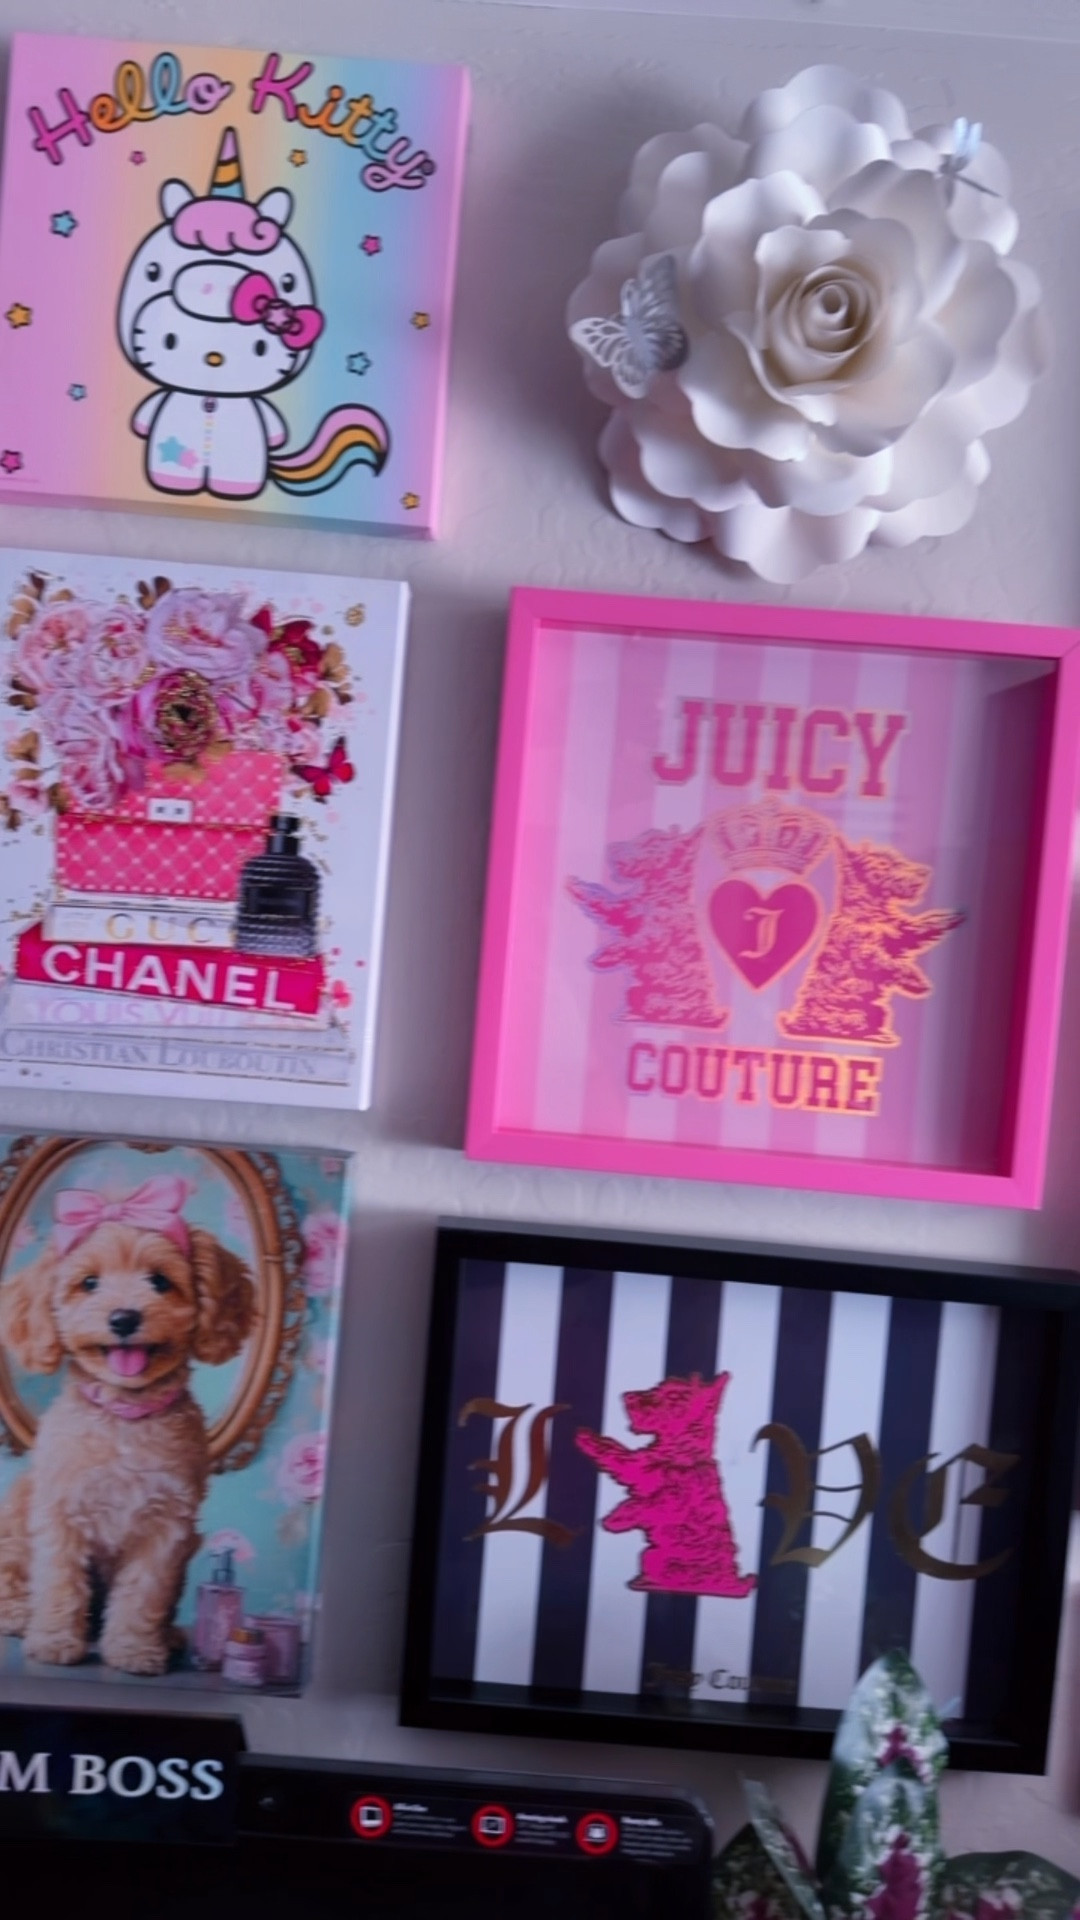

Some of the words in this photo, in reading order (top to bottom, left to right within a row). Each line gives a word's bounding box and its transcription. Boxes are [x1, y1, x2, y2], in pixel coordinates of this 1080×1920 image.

[28, 51, 232, 165] Hello
[250, 53, 434, 192] Kitty
[653, 698, 906, 797] JUICY
[105, 913, 239, 944] GUC
[41, 944, 296, 1011] CHANEL
[627, 1043, 881, 1115] COUTURE
[68, 1754, 225, 1801] BOSS
